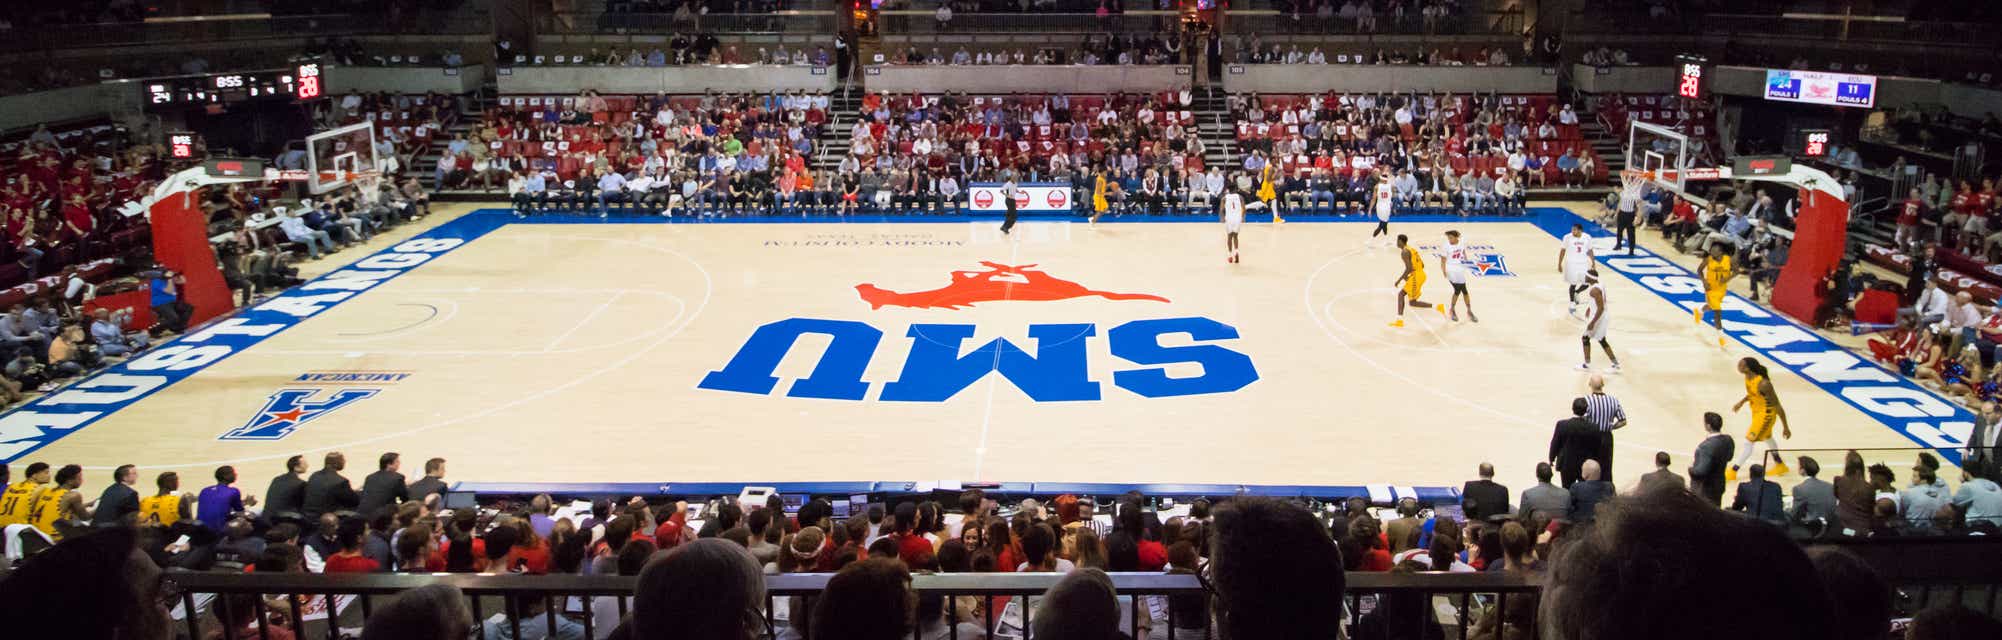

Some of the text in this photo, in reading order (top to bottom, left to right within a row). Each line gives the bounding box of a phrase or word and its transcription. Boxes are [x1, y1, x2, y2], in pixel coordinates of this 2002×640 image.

[1681, 75, 1698, 97] 28
[0, 237, 465, 461] MUSTANGS
[695, 316, 1260, 403] SMU
